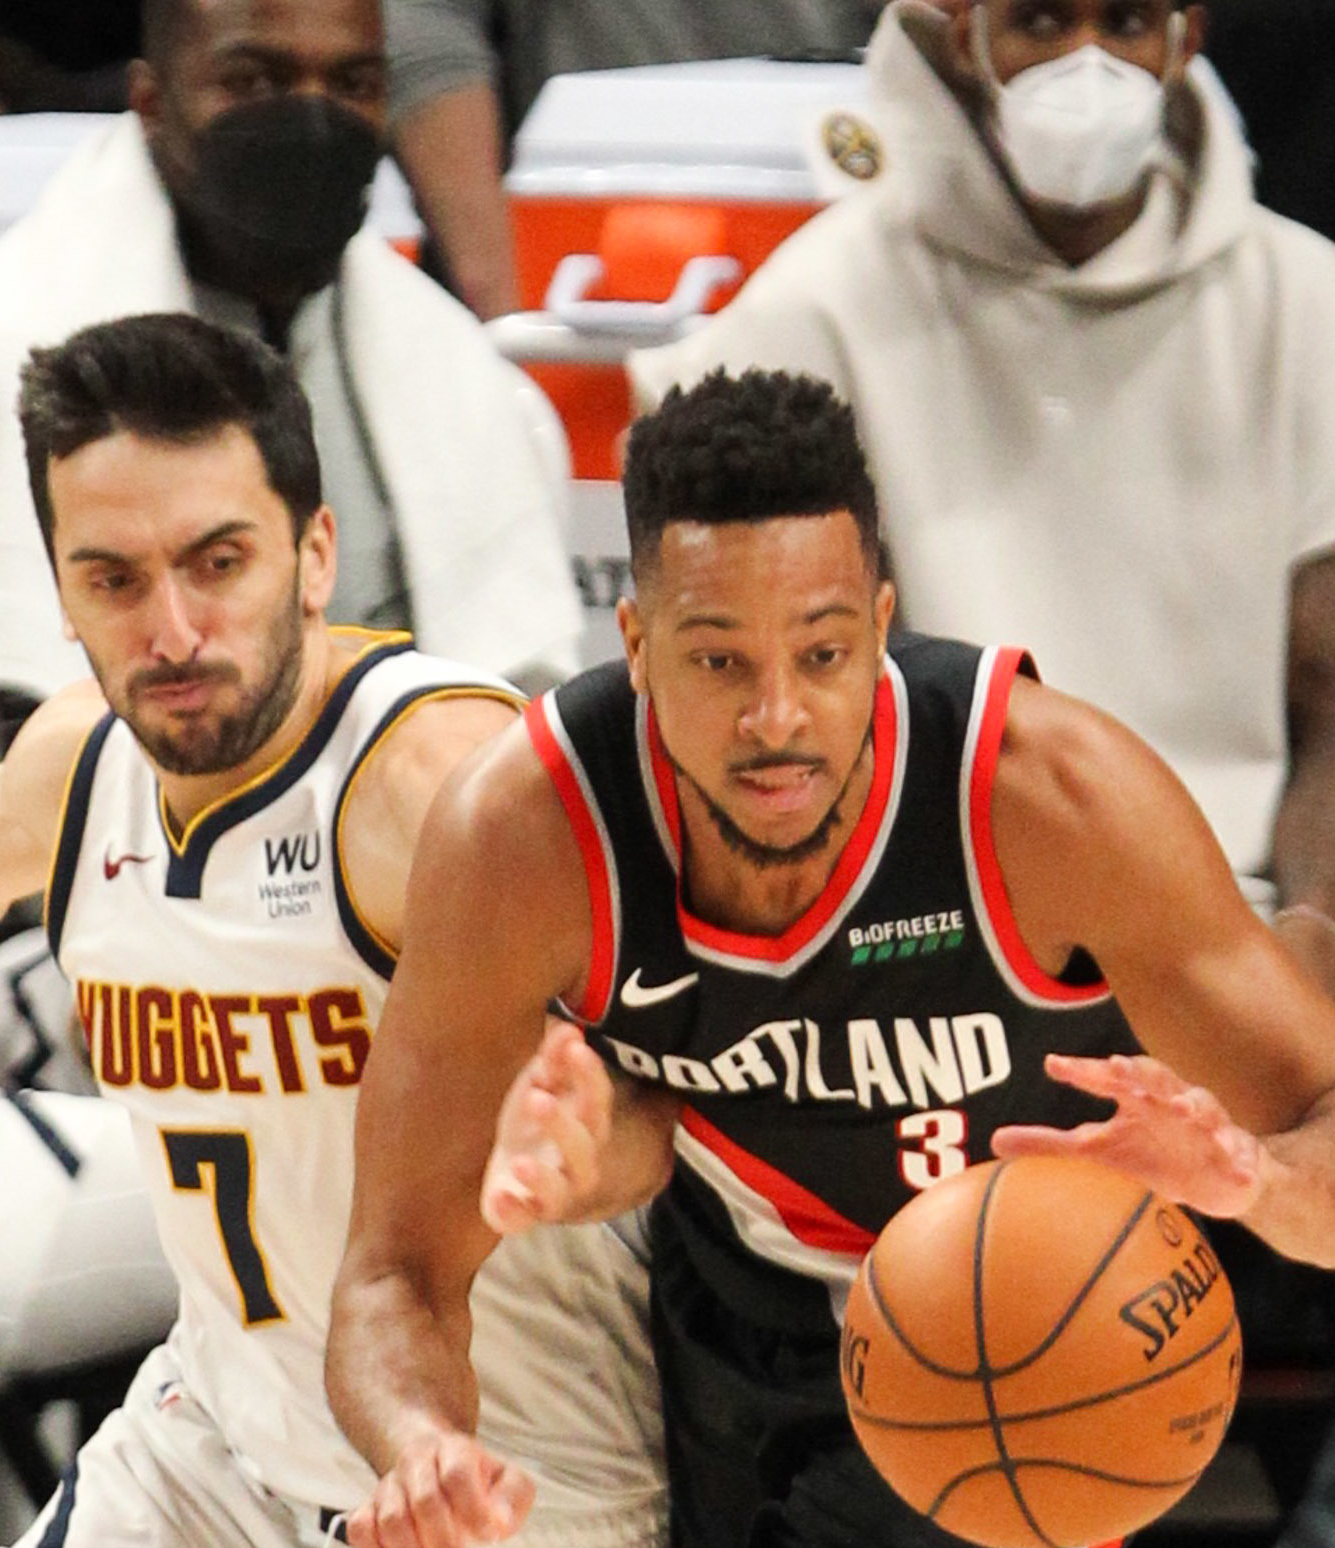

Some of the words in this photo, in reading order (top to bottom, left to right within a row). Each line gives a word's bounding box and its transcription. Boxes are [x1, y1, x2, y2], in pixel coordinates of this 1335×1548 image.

[264, 828, 321, 877] WU
[257, 880, 322, 901] Western
[266, 899, 313, 919] Union
[605, 1010, 1013, 1110] PORTLAND
[897, 1107, 969, 1192] 3
[157, 1124, 290, 1333] 7
